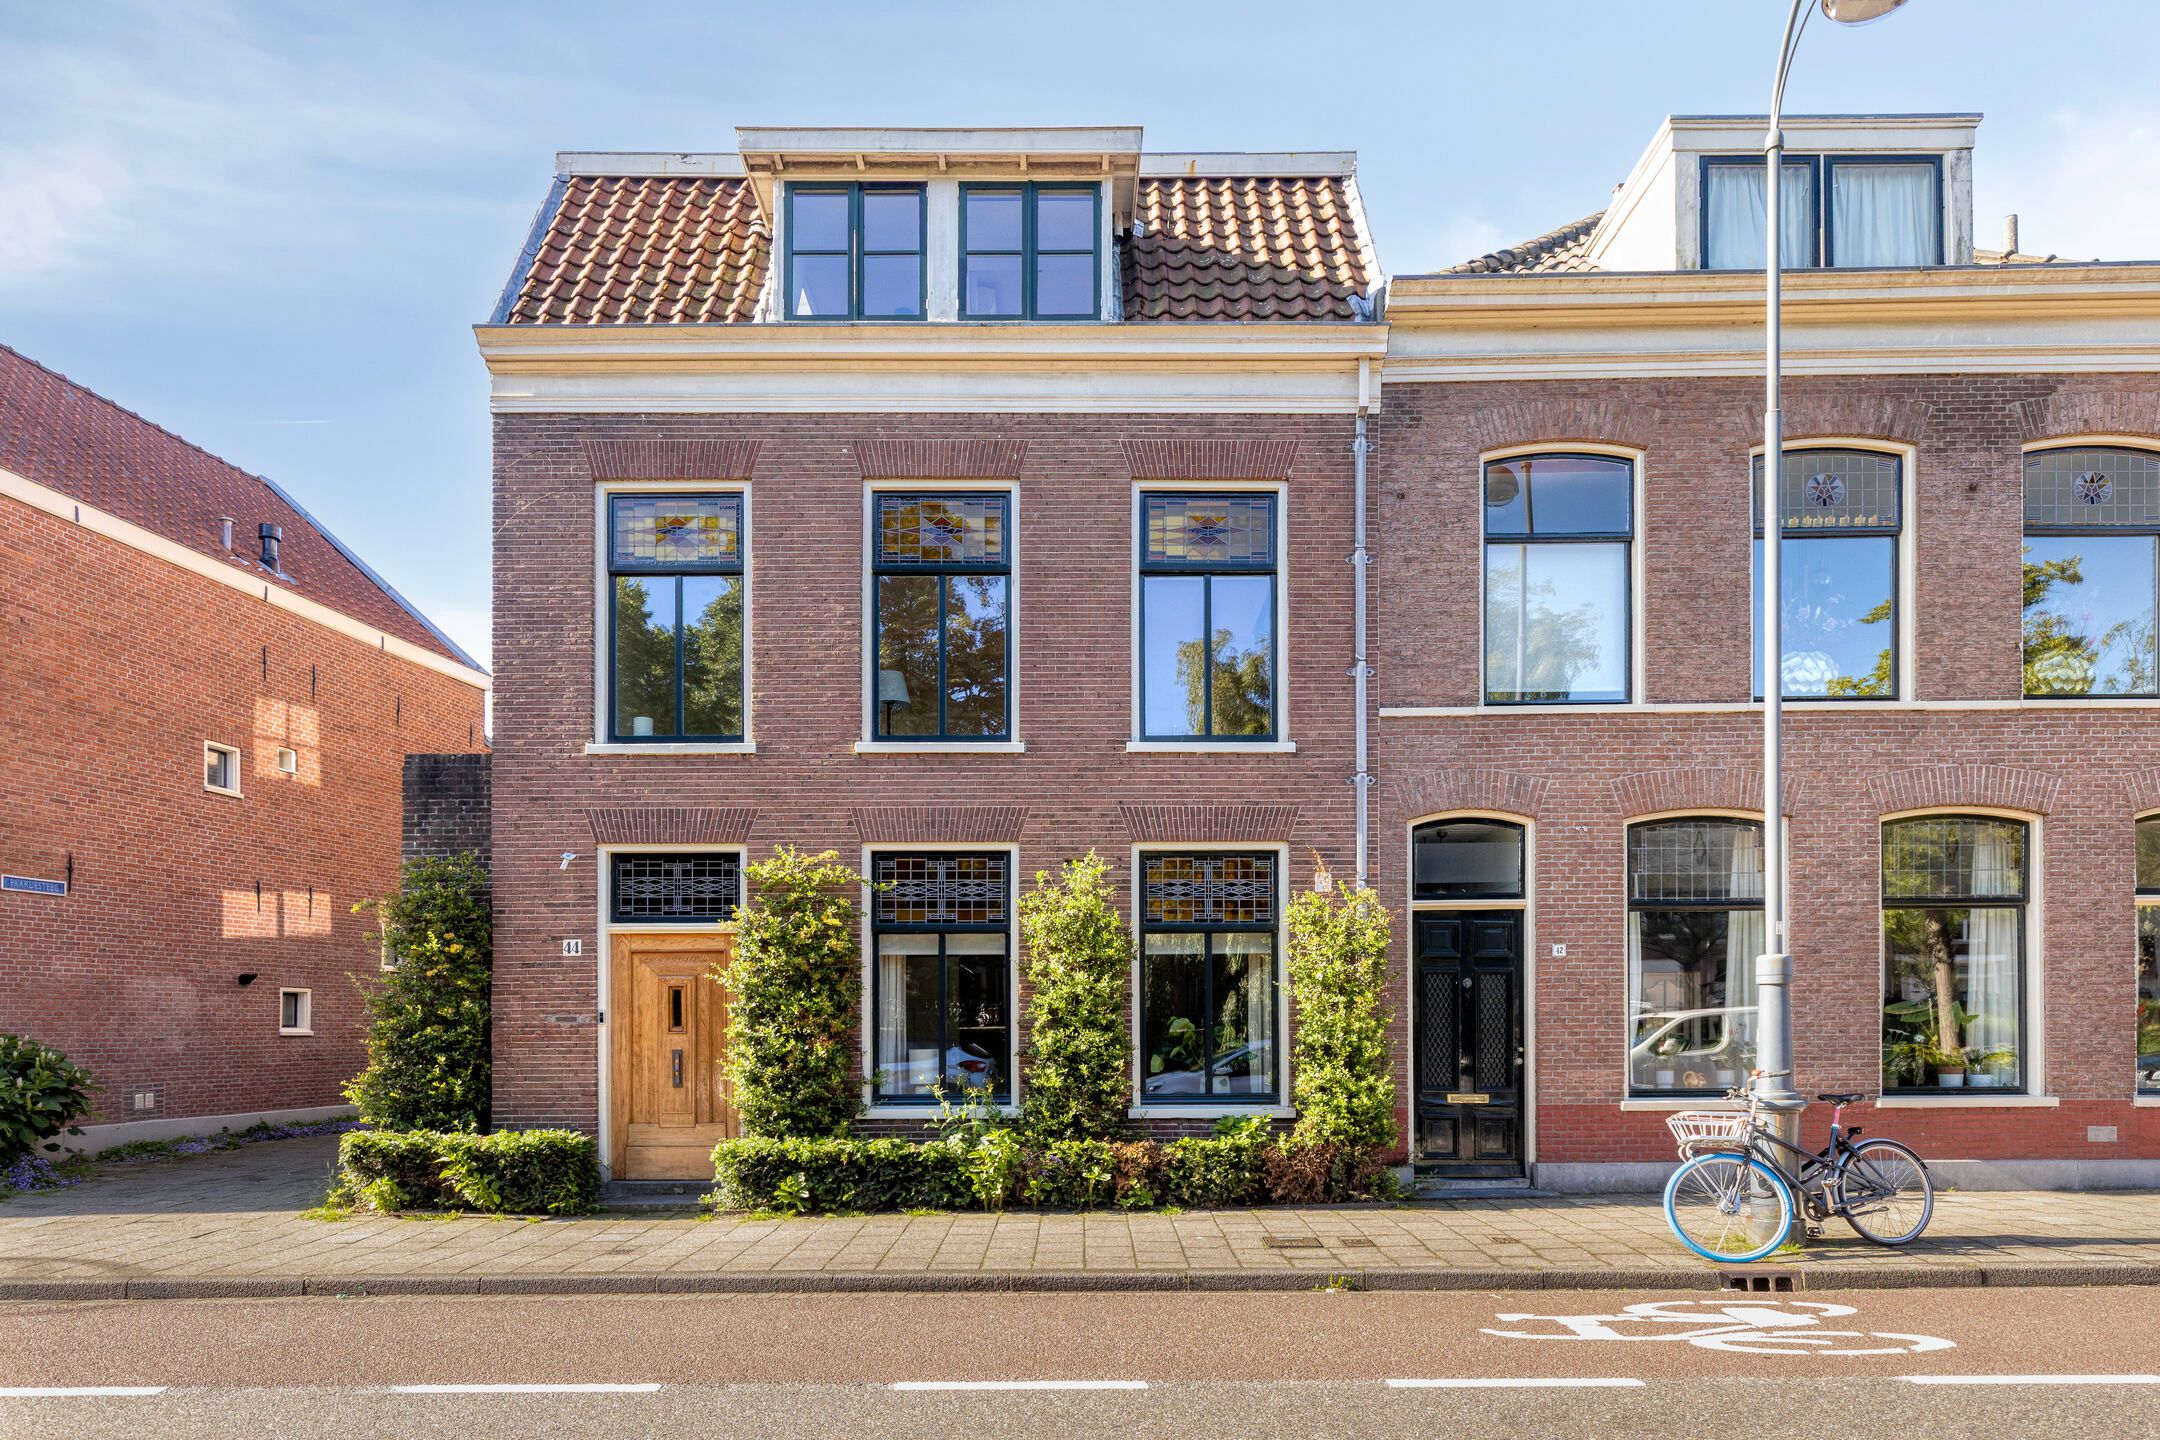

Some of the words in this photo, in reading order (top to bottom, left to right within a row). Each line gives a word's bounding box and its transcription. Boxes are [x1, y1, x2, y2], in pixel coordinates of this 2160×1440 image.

[9, 878, 59, 893] PAARDESTEEG
[563, 941, 580, 954] 44
[1556, 946, 1564, 954] 42
